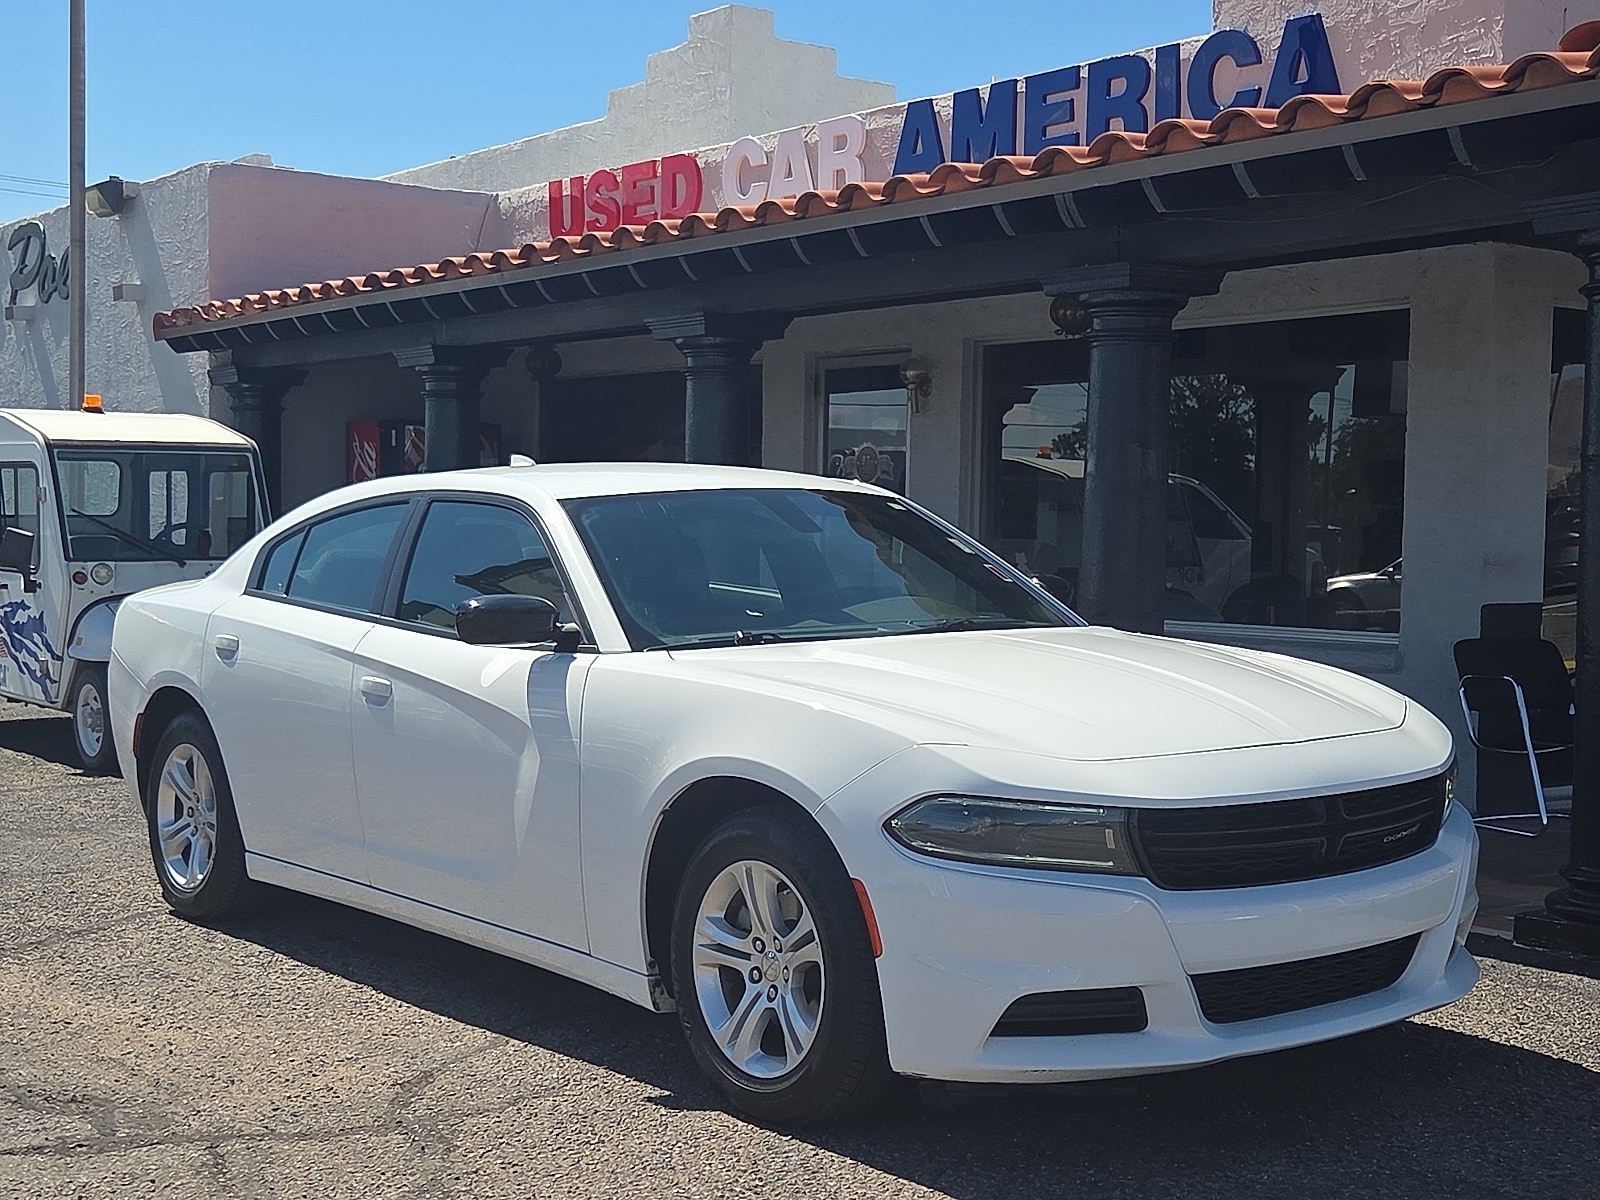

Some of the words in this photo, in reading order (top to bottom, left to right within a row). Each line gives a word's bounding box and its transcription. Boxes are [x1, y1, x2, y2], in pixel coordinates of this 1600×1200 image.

[548, 154, 703, 239] USED
[722, 114, 867, 206] CAR
[891, 13, 1341, 177] AMERICA
